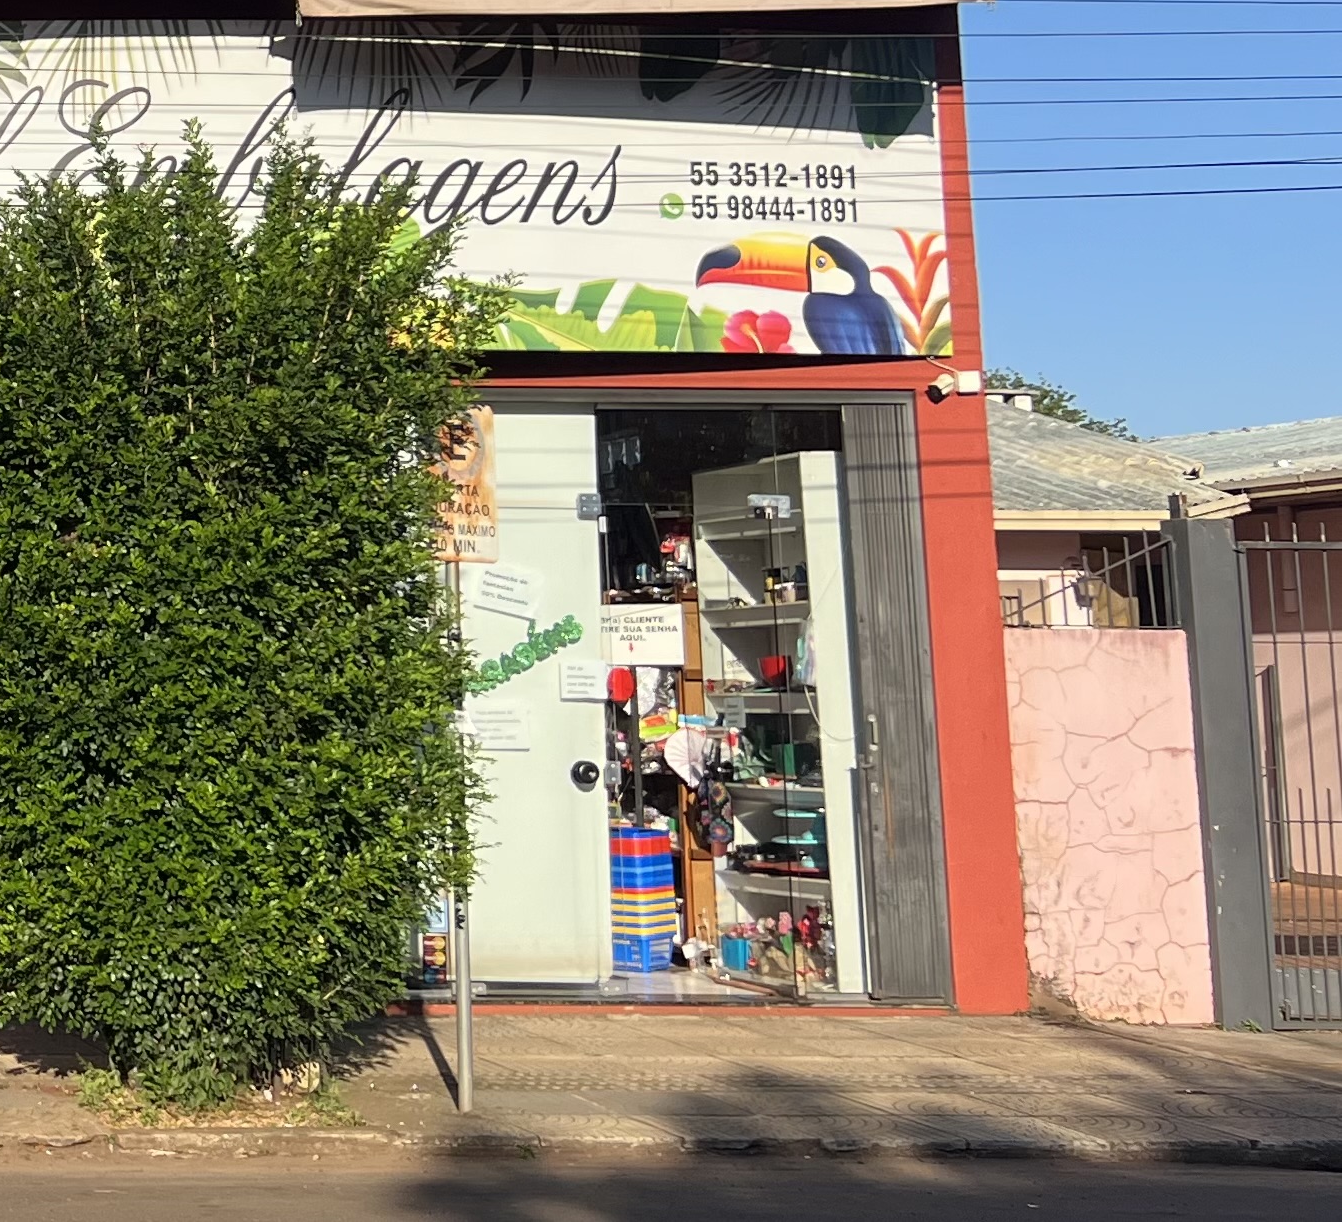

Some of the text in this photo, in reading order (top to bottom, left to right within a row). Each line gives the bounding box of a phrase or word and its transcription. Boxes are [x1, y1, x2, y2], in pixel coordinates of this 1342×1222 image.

[689, 161, 857, 190] 55 3512-1891
[691, 194, 858, 223] 55 98444-1891
[623, 625, 643, 633] SUA
[645, 625, 679, 633] SENHA
[624, 616, 664, 624] CLIENTE
